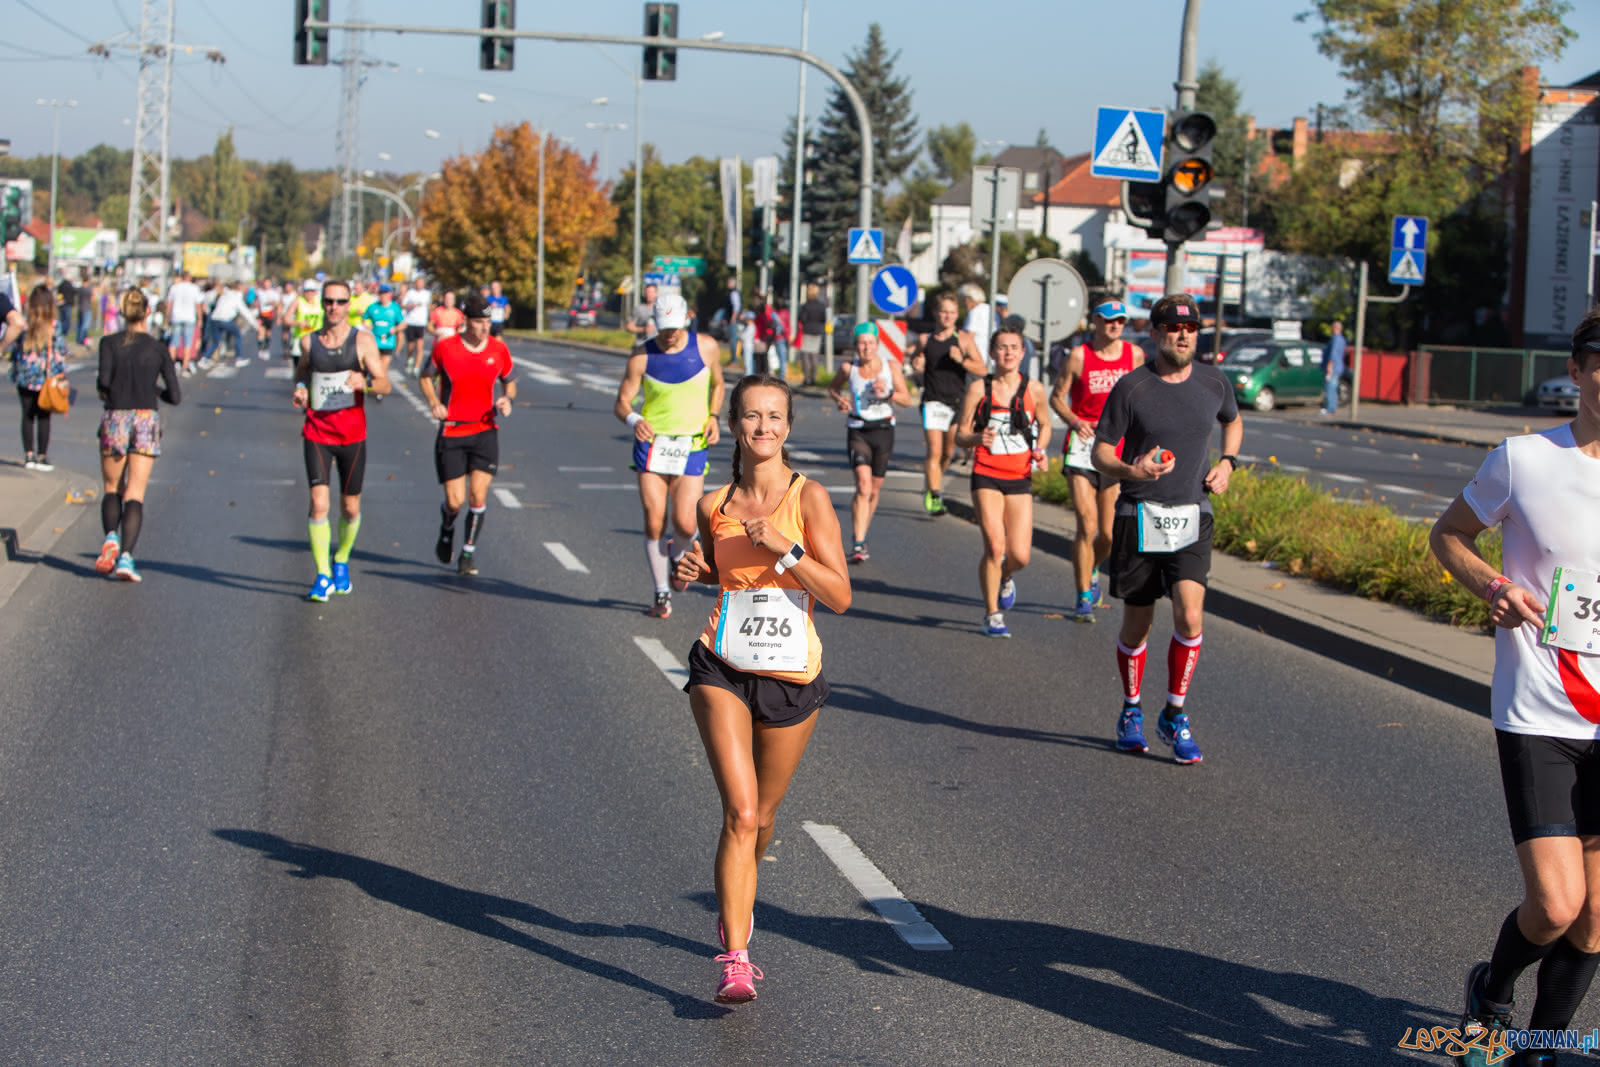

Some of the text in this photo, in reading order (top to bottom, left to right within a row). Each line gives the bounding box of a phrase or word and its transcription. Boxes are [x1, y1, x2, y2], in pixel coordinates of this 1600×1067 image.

[660, 447, 688, 458] 2404
[1153, 516, 1188, 530] 3897
[739, 617, 792, 637] 4736
